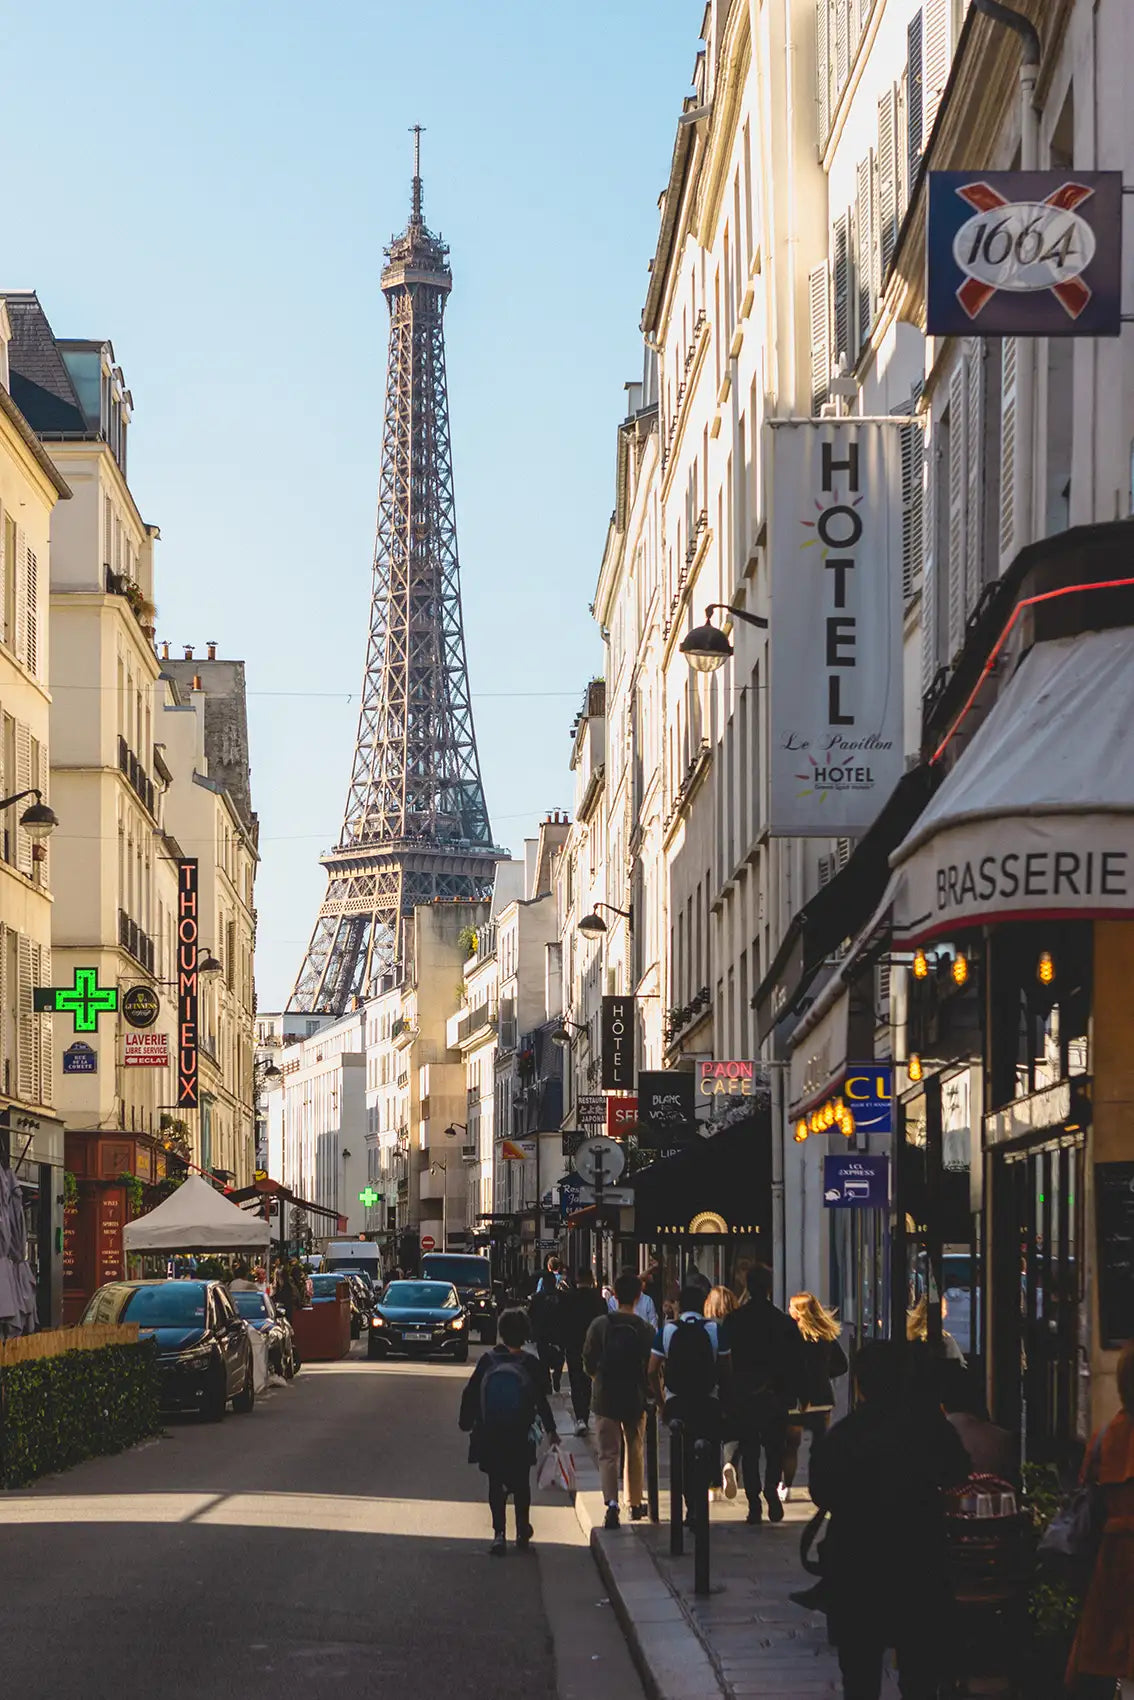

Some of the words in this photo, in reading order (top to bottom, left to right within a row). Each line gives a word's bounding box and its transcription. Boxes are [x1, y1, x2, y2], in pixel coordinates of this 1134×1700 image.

[967, 216, 1080, 268] 1664
[818, 442, 863, 725] HOTEL
[781, 731, 810, 751] Le
[820, 733, 893, 751] Pavillon
[815, 767, 875, 782] HOTEL
[936, 851, 1128, 910] BRASSERIE
[179, 865, 198, 1101] THOUMIEUX
[125, 1034, 167, 1045] LAVERIE
[612, 1004, 625, 1082] HÔTEL
[700, 1078, 753, 1096] CAFE
[701, 1061, 753, 1078] PAON
